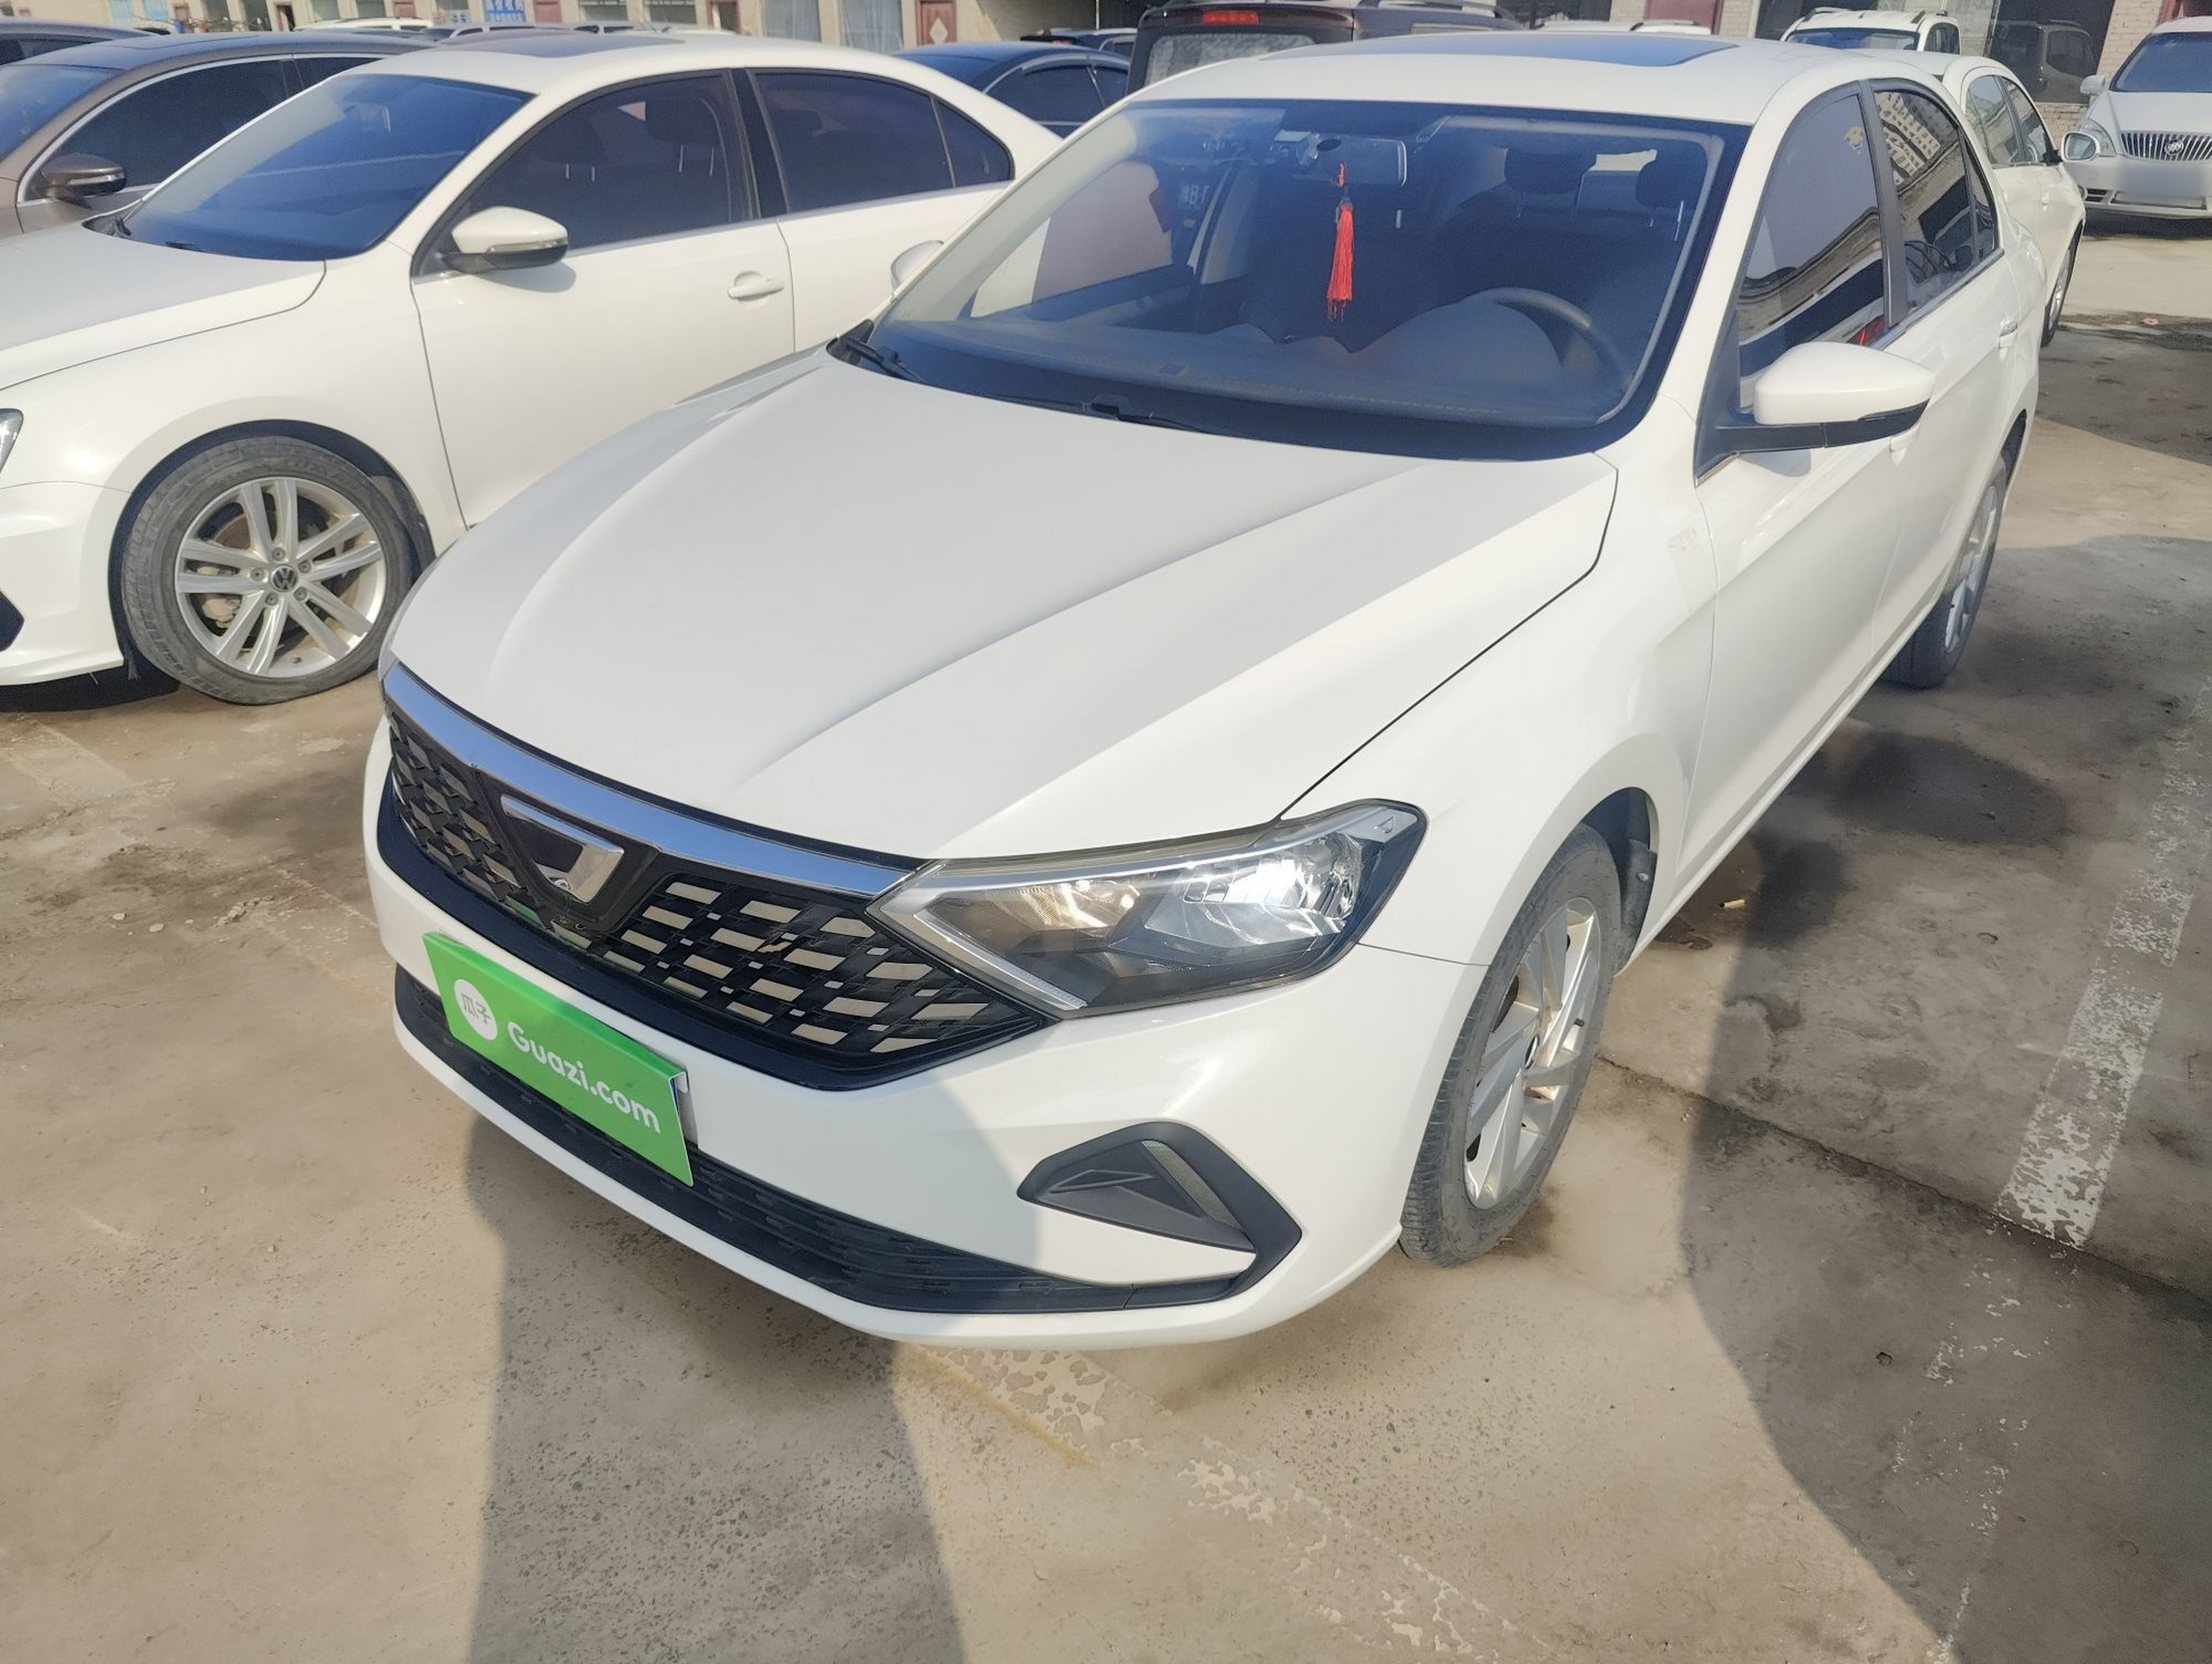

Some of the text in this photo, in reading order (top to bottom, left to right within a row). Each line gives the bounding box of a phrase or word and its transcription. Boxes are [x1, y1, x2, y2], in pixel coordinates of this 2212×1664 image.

[272, 565, 298, 592] VW
[460, 992, 492, 1025] 瓜子
[508, 1021, 660, 1133] Guazi.com
